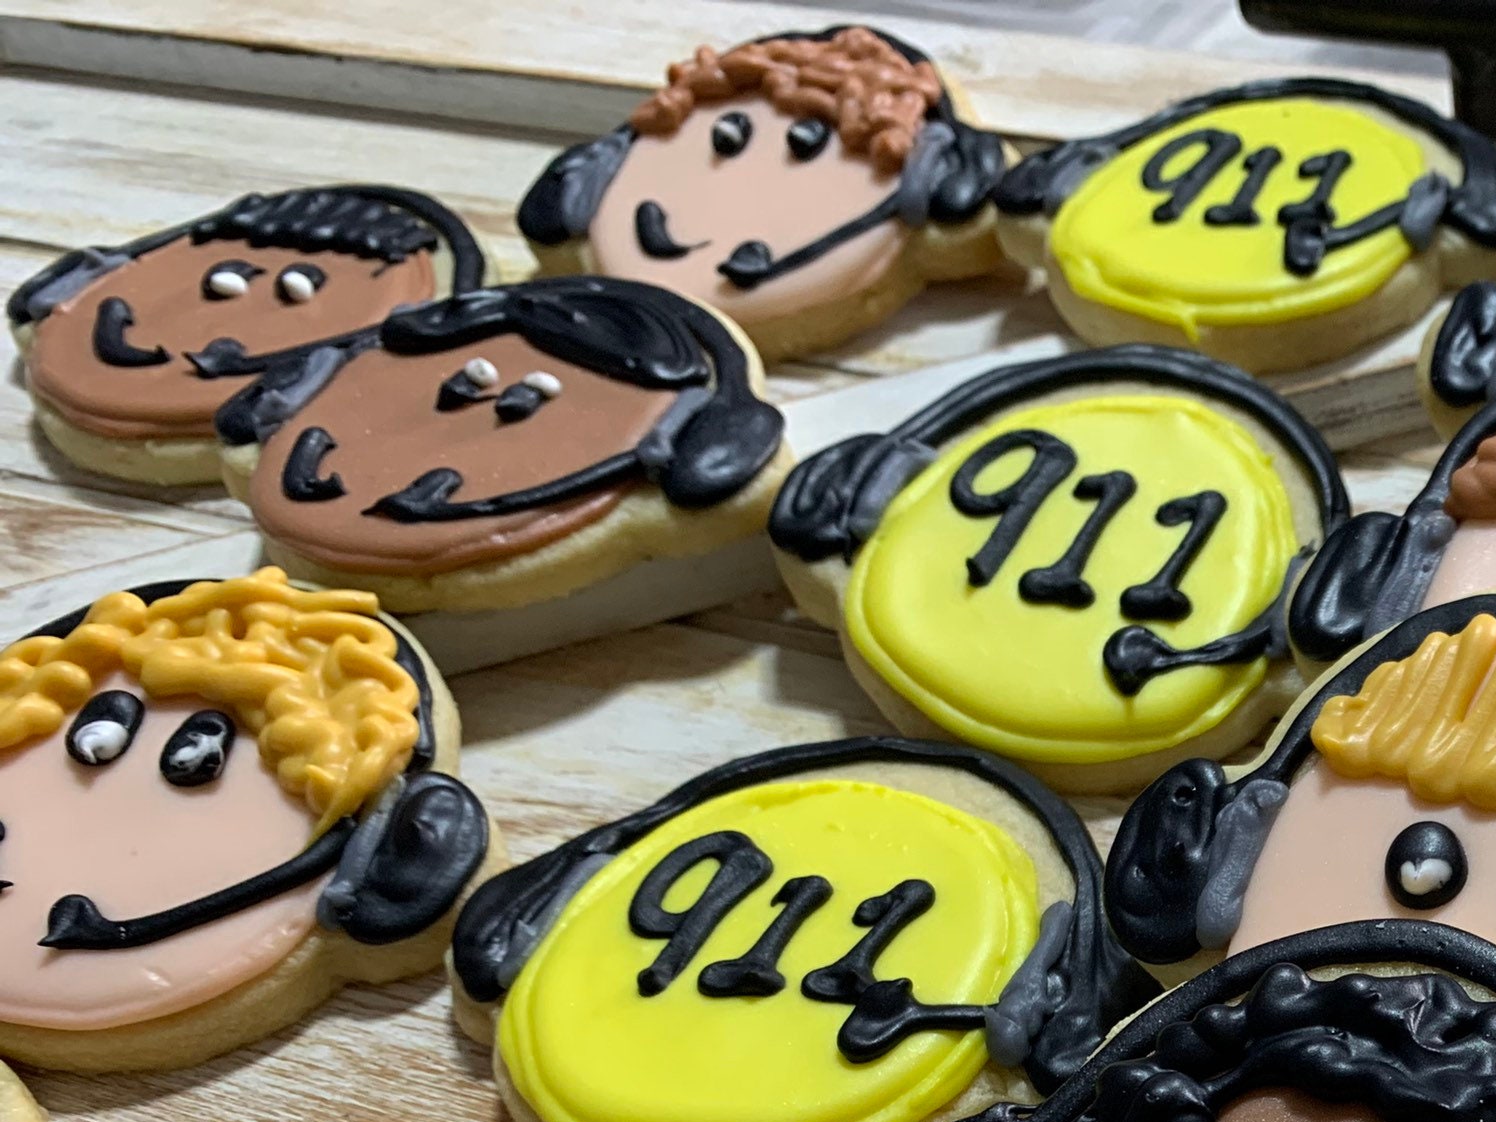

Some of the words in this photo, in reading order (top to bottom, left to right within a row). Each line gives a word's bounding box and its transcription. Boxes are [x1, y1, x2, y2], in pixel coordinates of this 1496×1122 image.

[1141, 128, 1352, 228] 911
[949, 428, 1228, 622] 911
[628, 830, 936, 1003] 911
